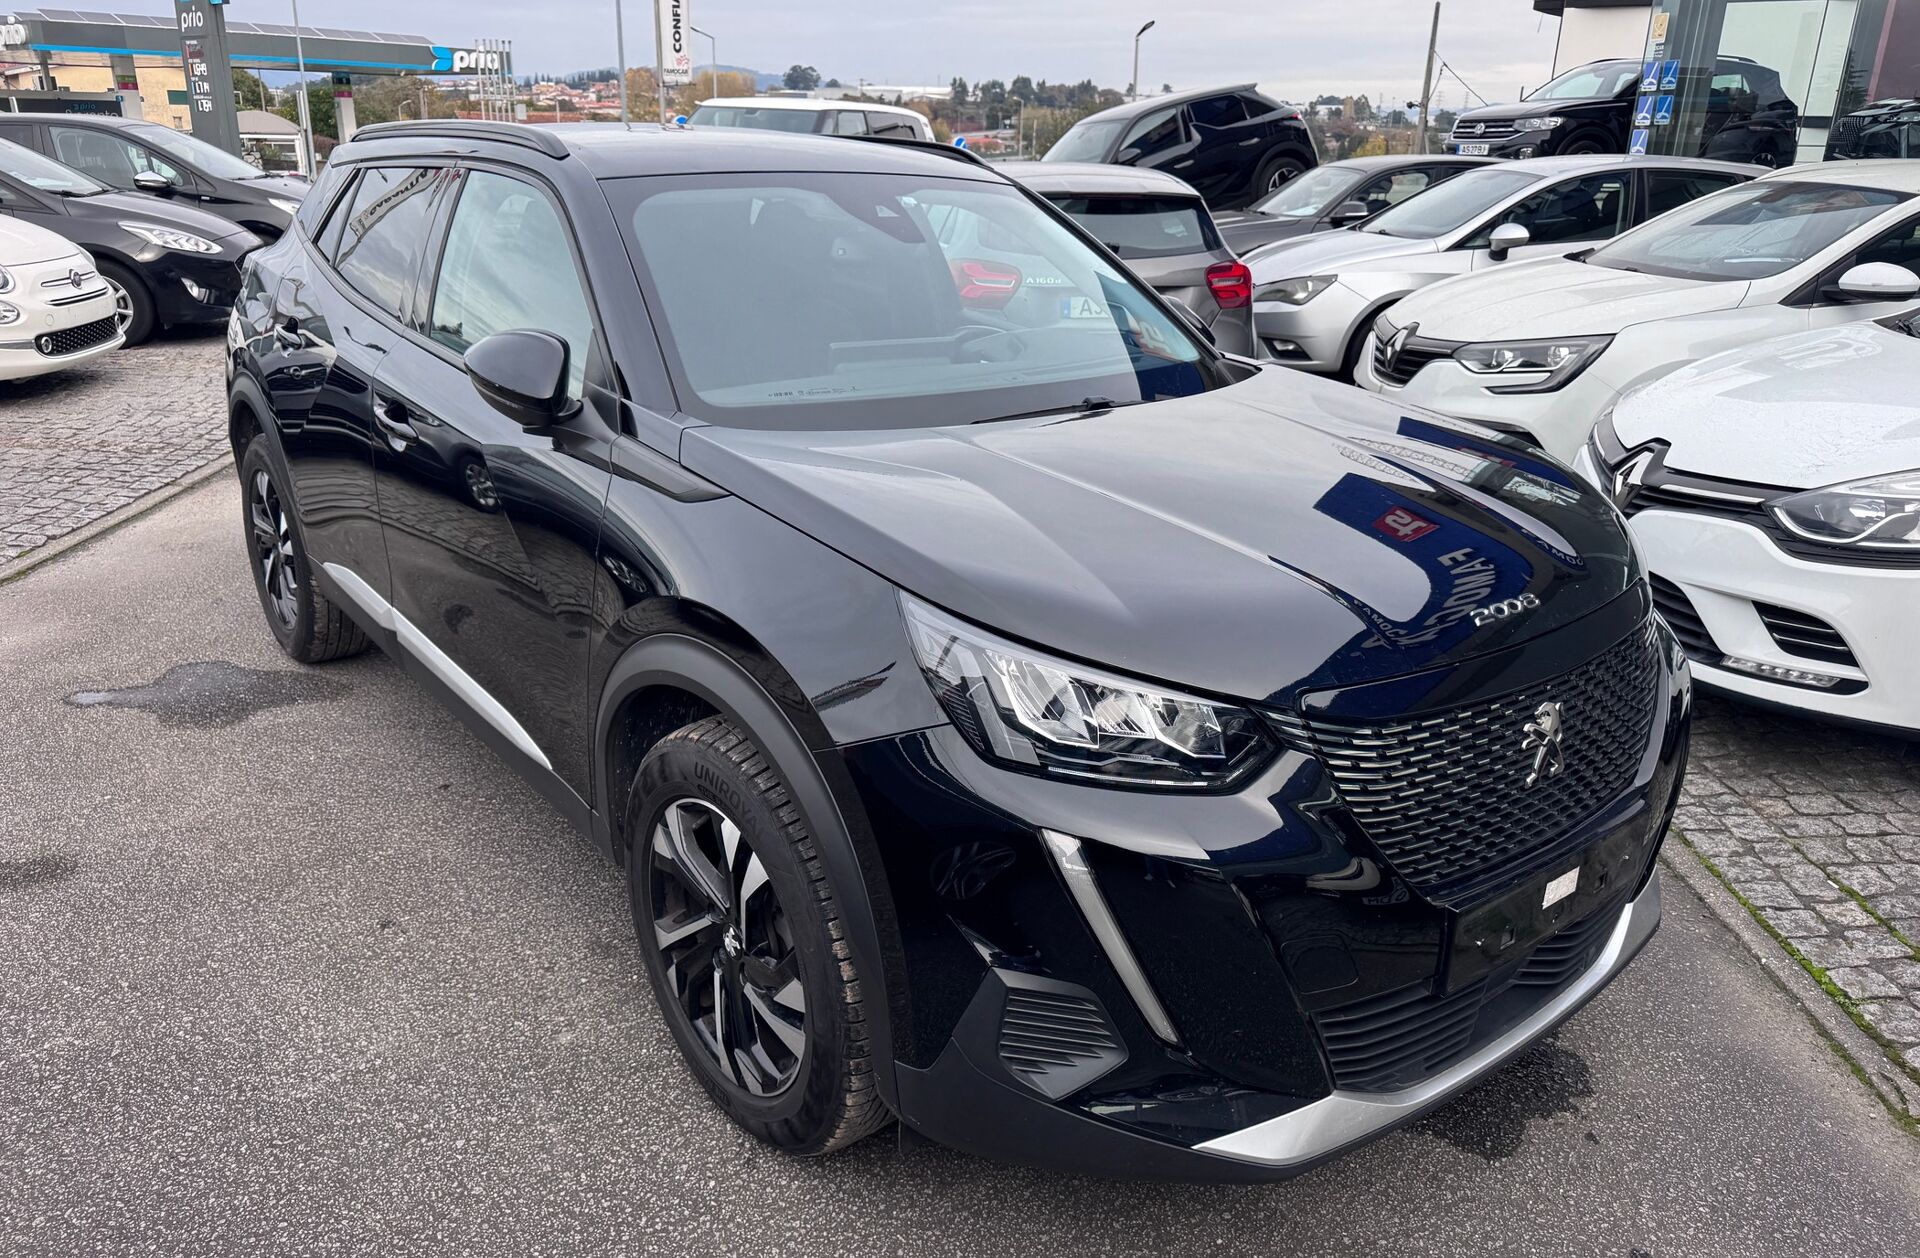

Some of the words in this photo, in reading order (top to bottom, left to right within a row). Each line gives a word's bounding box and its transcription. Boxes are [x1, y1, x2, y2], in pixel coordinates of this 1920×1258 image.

[181, 5, 204, 32] prio
[672, 0, 682, 53] CONFI
[453, 45, 499, 72] prio
[1470, 593, 1539, 627] 2008
